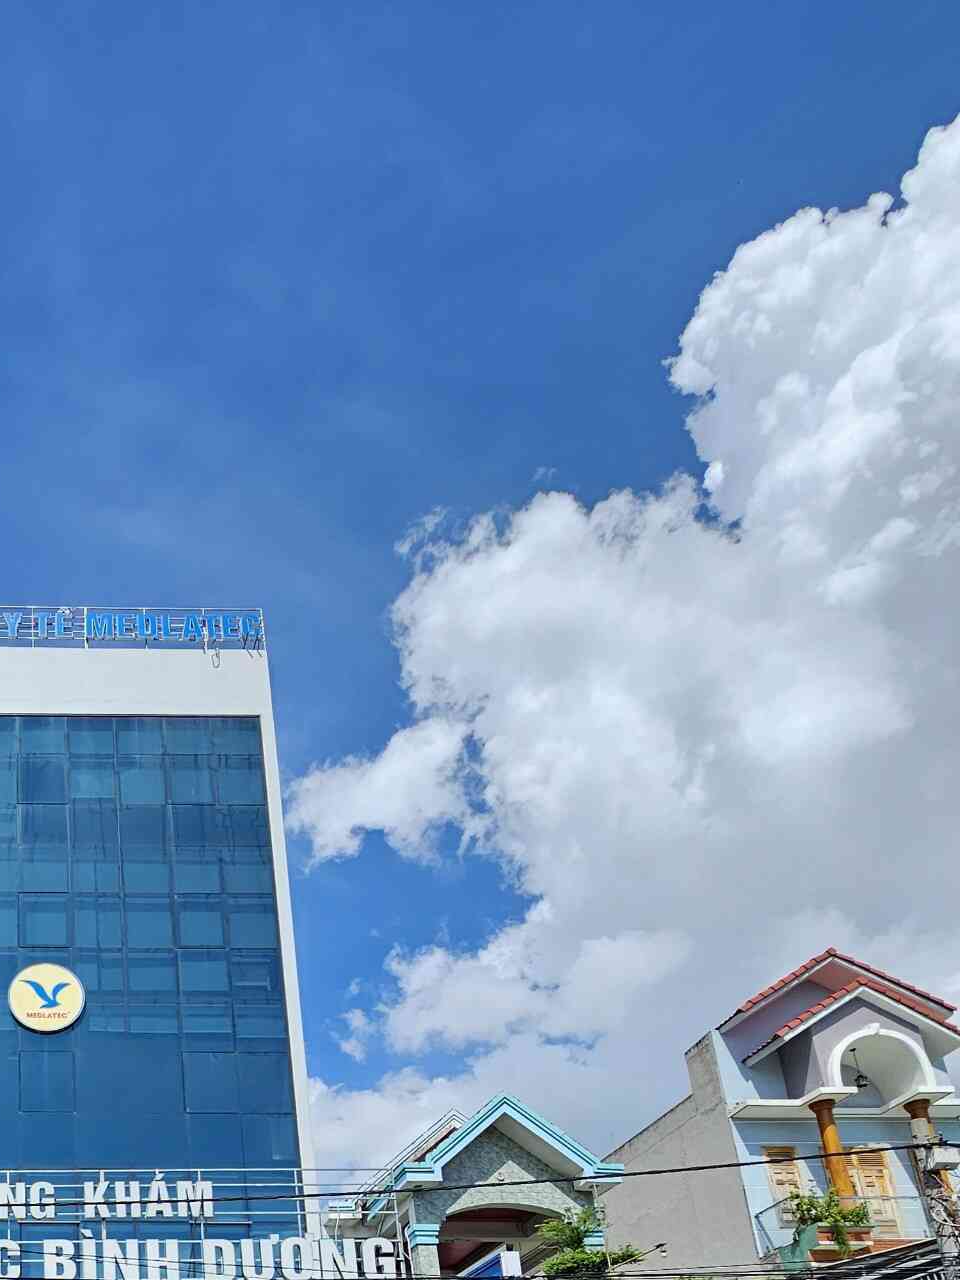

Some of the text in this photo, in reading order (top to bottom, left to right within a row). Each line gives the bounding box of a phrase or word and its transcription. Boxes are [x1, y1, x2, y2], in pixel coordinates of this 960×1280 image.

[3, 611, 25, 637] Y
[85, 611, 263, 641] MEDLATEC
[83, 1170, 215, 1219] KHÁM
